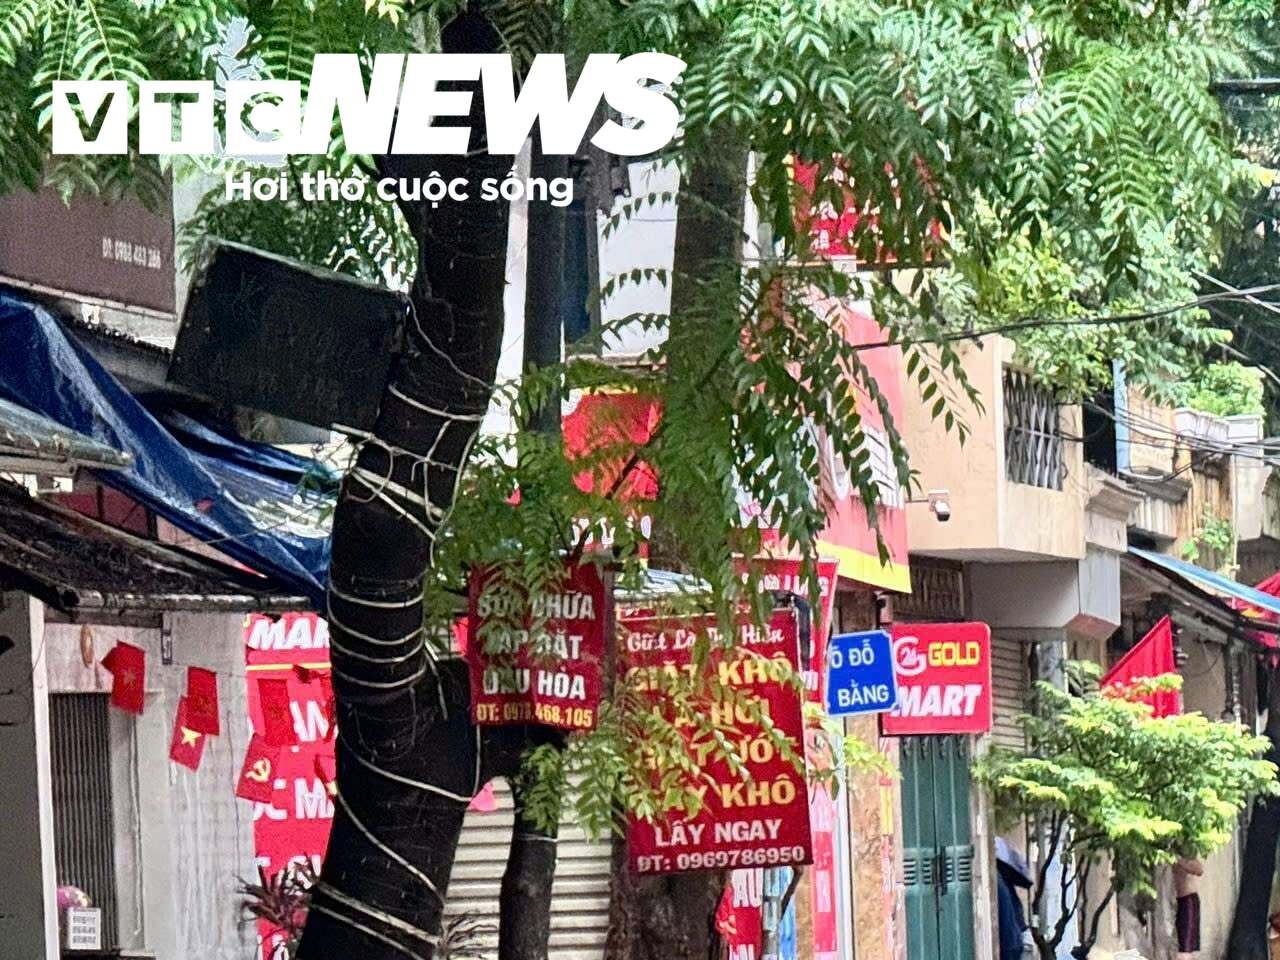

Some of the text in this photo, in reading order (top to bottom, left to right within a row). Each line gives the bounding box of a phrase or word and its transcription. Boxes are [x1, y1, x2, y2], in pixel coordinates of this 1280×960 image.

[927, 640, 981, 666] GOLD
[837, 678, 890, 708] BẰNG
[890, 683, 982, 717] MART
[721, 773, 797, 809] KHÔ
[655, 818, 783, 848] LẤY NGAY
